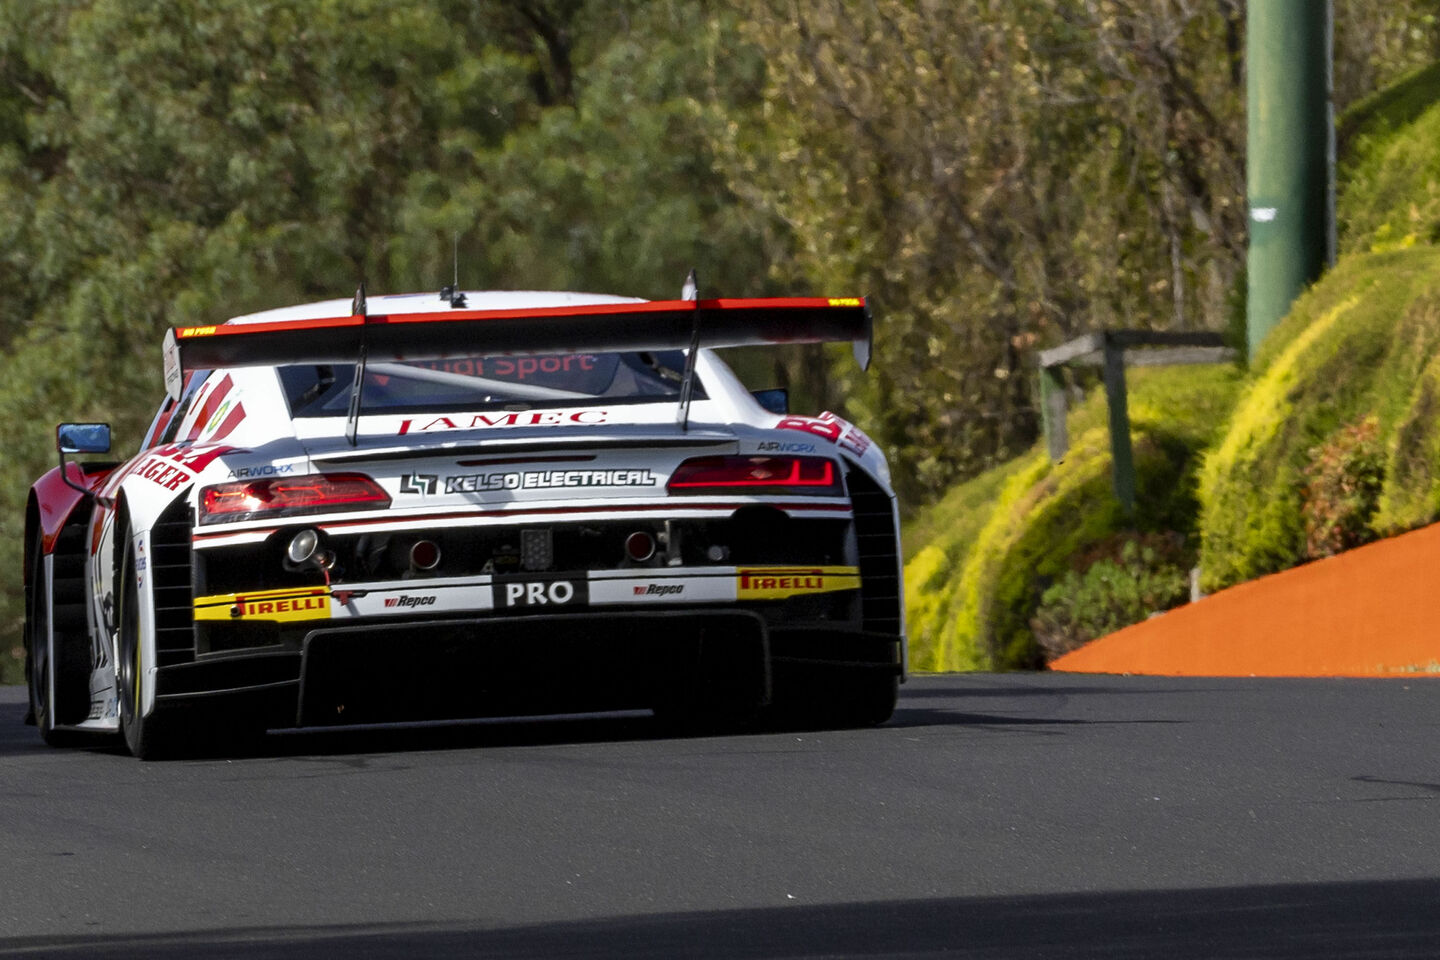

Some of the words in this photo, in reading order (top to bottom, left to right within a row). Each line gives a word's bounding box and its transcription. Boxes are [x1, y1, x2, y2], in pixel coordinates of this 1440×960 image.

[397, 411, 608, 436] JAMEC
[227, 463, 294, 479] AIRWORX
[445, 472, 520, 495] KELSO
[522, 468, 656, 490] ELECTRICAL
[646, 583, 684, 597] Repco
[741, 569, 823, 590] PIRELLI
[397, 595, 437, 608] Repco
[506, 581, 574, 606] PRO
